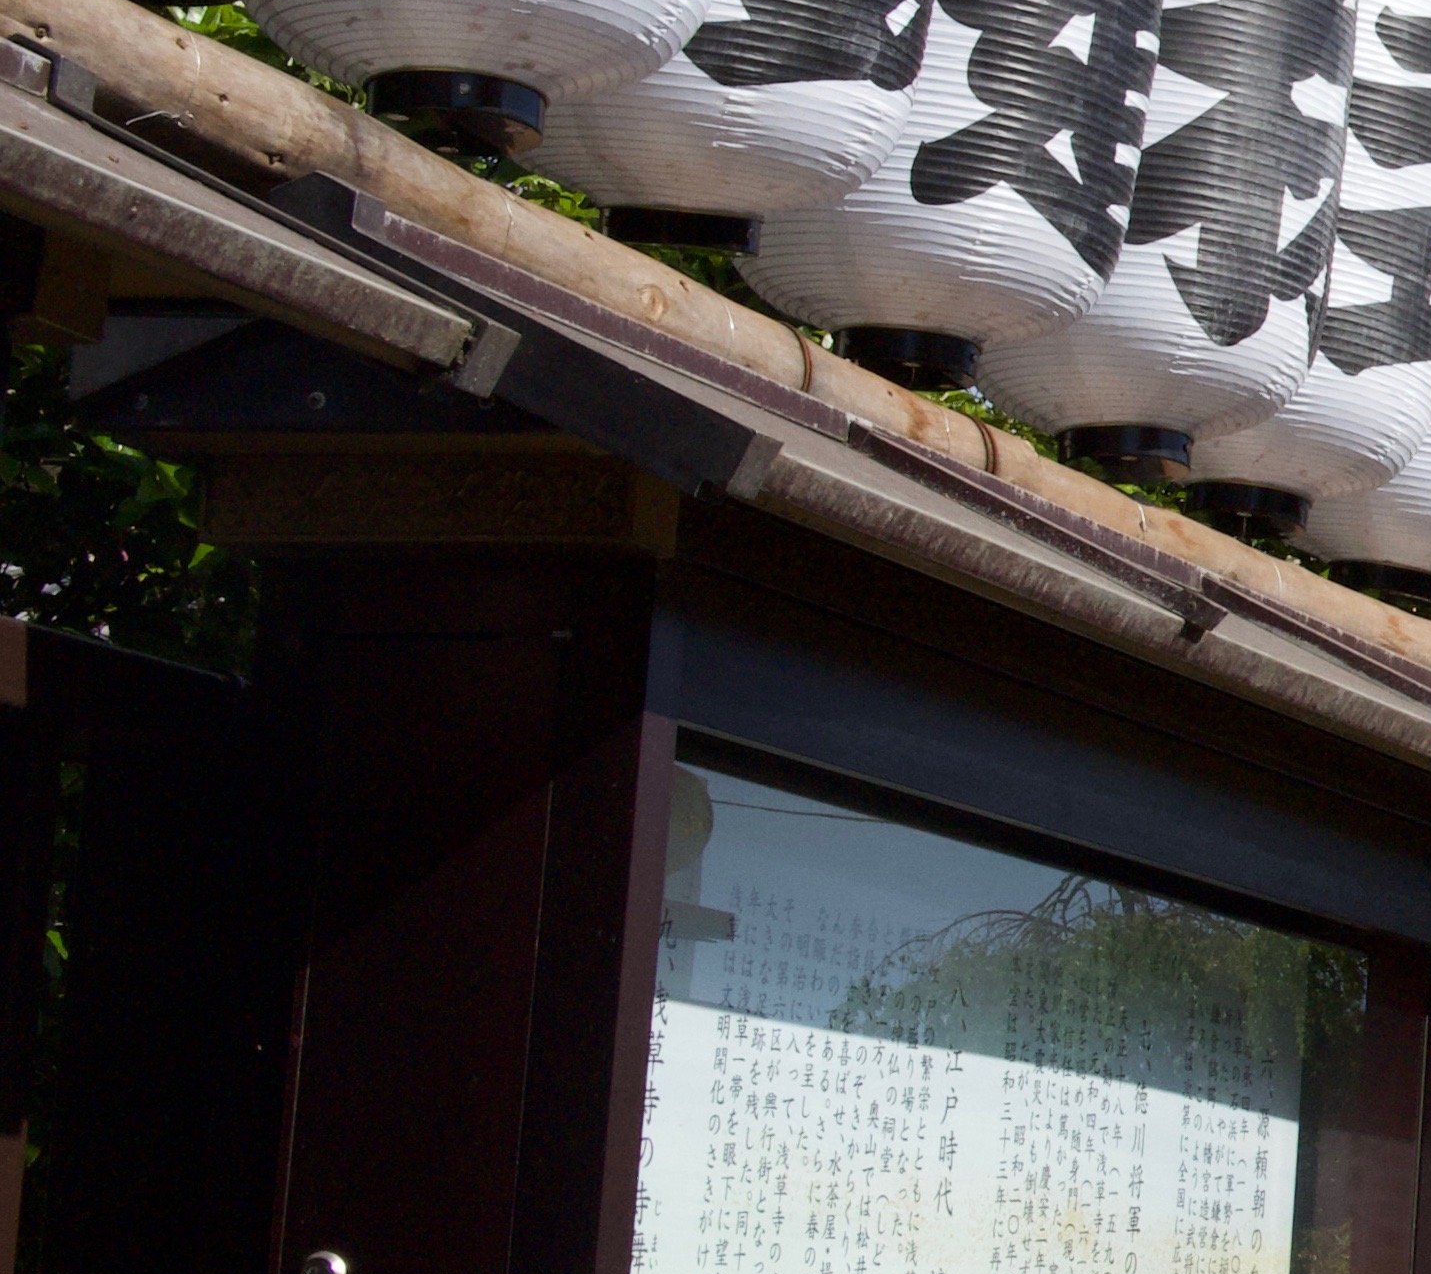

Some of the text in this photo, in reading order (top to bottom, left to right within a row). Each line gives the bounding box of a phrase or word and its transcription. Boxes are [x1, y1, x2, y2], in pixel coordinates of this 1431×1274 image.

[933, 982, 969, 1217] 八、江戸時代
